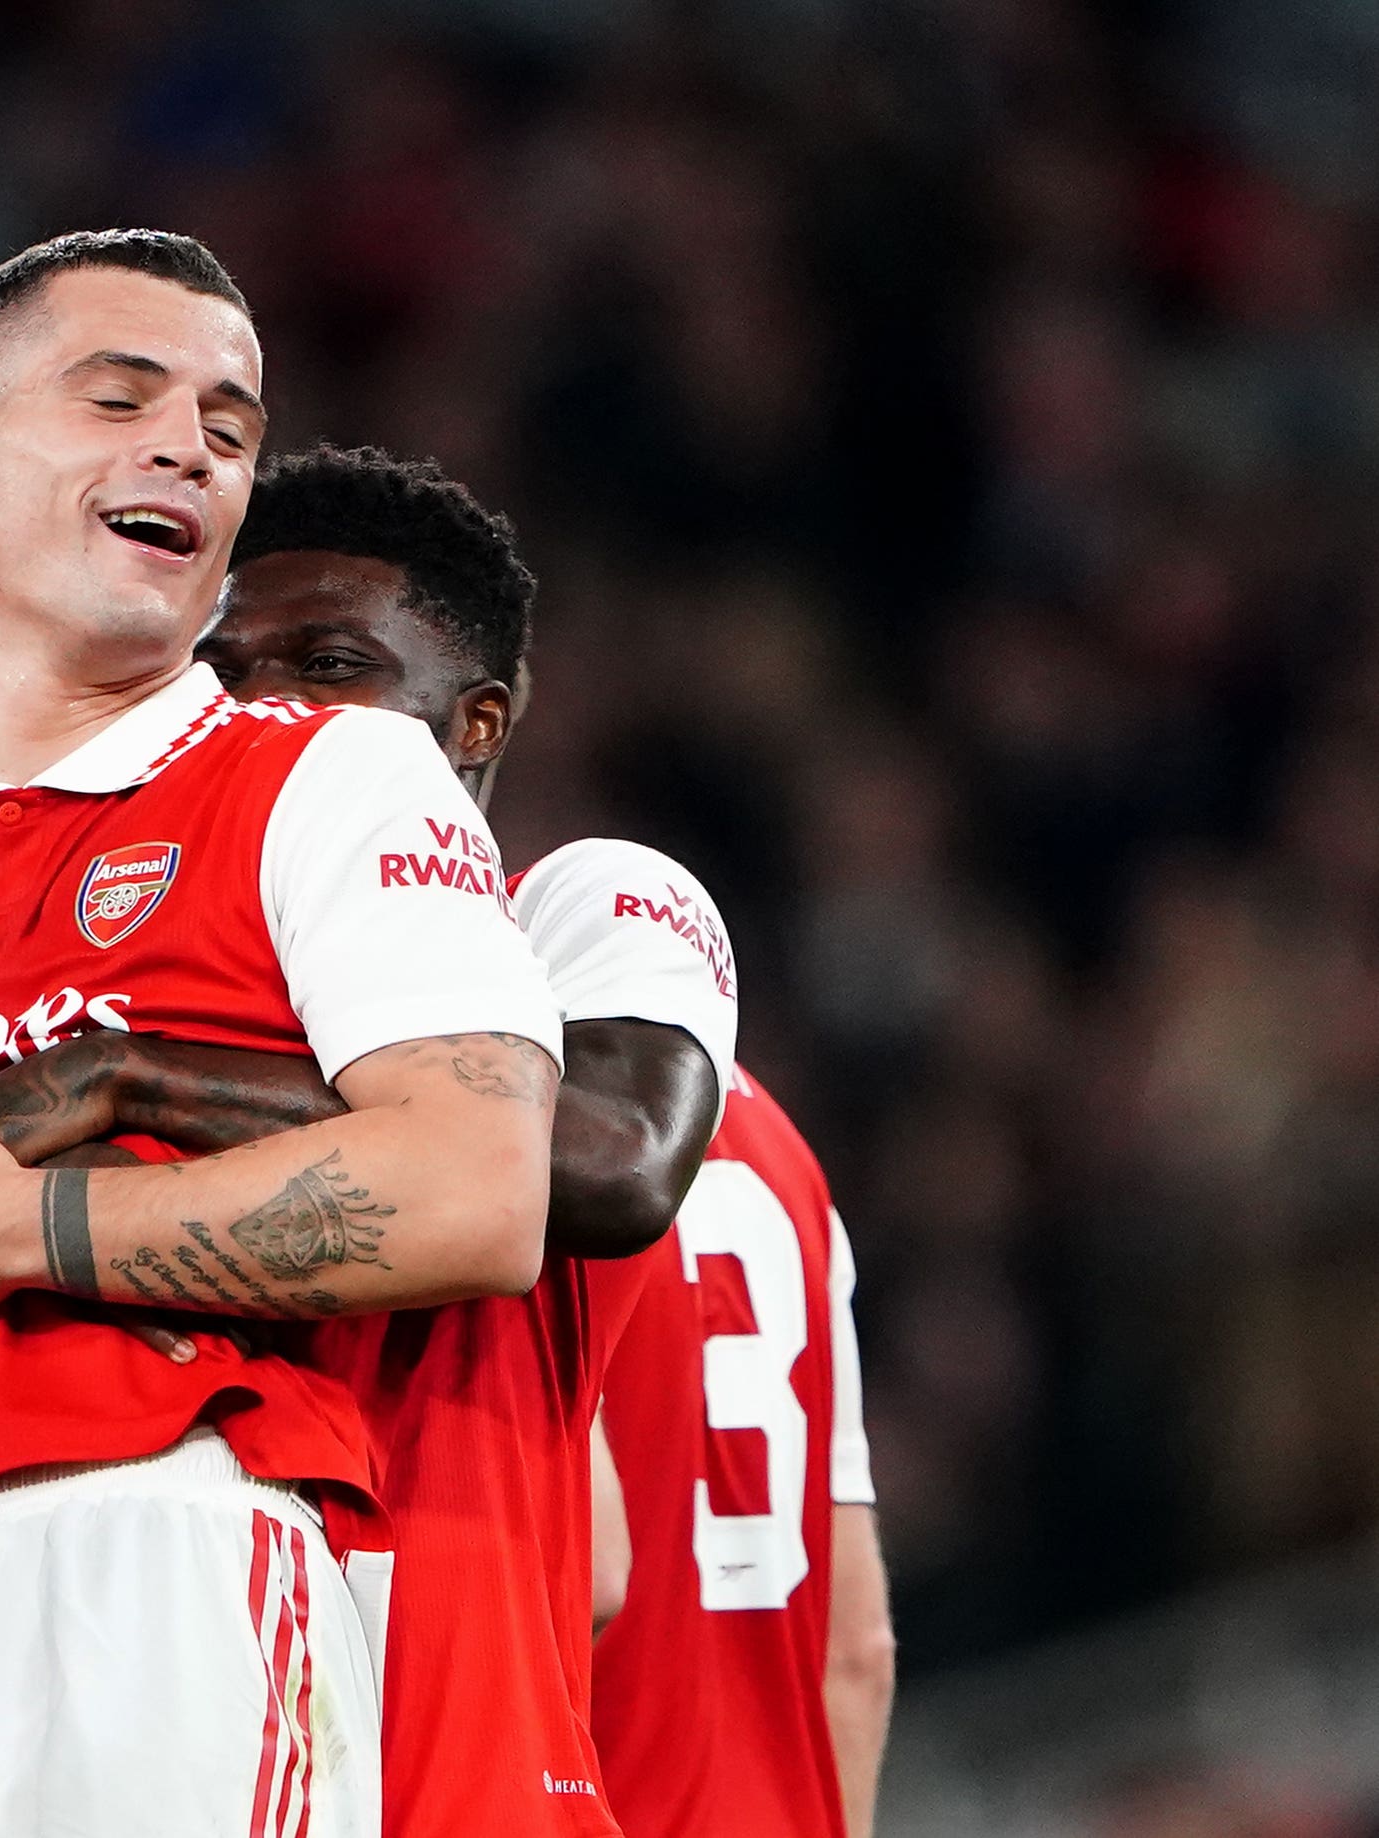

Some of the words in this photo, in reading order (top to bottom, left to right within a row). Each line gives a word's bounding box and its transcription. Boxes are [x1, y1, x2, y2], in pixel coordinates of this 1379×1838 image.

[95, 855, 167, 881] Arsenal
[614, 892, 737, 1002] RWAND
[676, 1159, 809, 1611] 3
